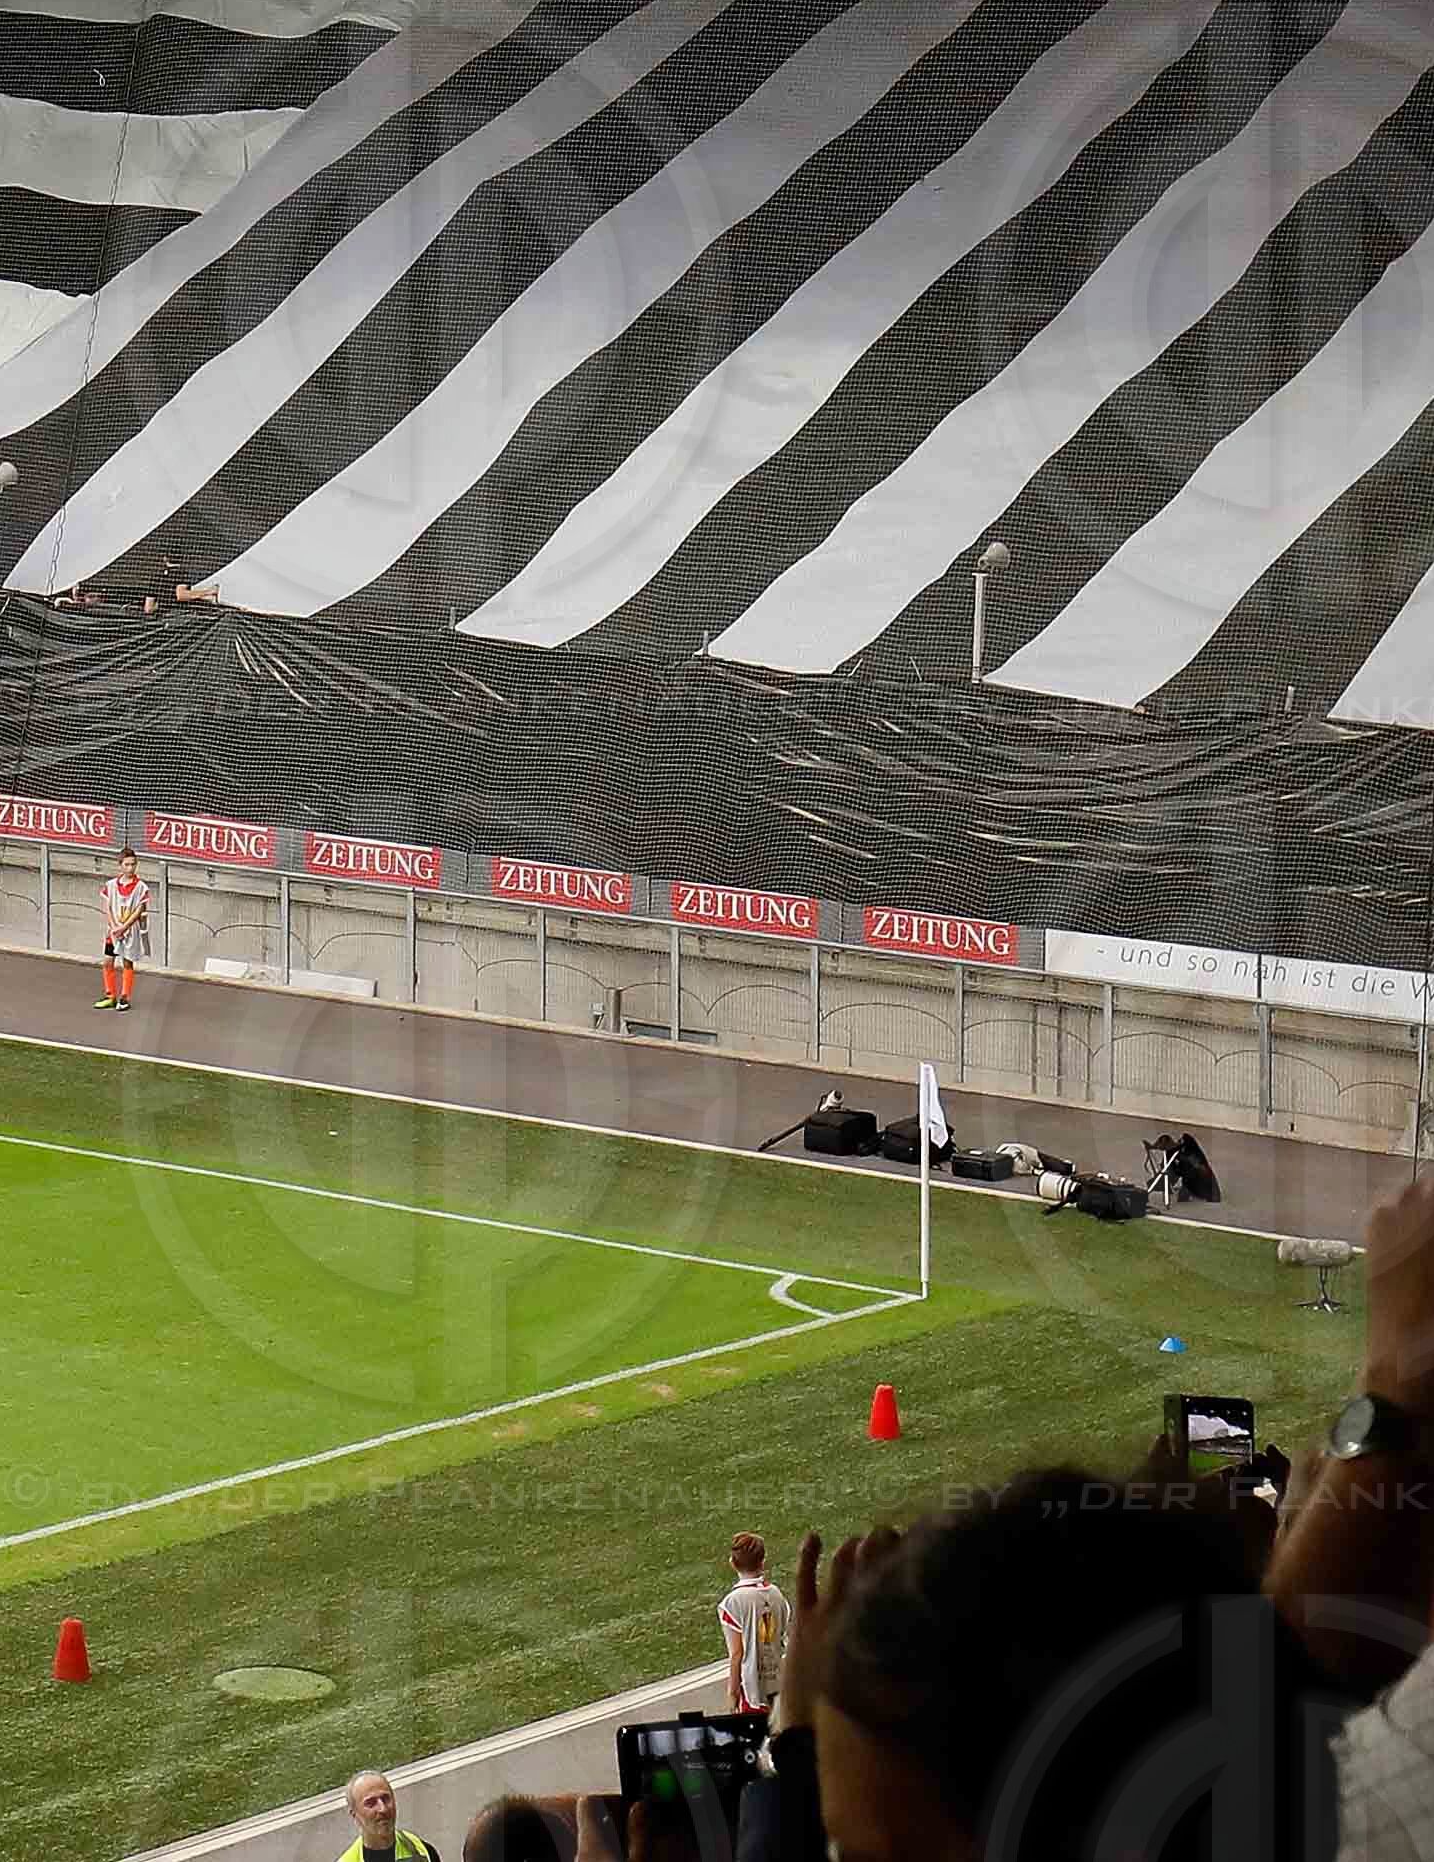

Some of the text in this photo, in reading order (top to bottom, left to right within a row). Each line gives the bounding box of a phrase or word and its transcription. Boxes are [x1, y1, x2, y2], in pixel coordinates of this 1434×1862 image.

[153, 819, 268, 859] ZEITUNG
[312, 841, 433, 880] ZEITUNG
[499, 863, 624, 904] ZEITUNG
[678, 887, 810, 928] ZEITUNG
[871, 911, 1010, 955] ZEITUNG
[1119, 944, 1172, 968] und
[1187, 954, 1220, 973] so
[1234, 956, 1288, 982] nah
[1302, 962, 1336, 988] ist
[1352, 969, 1396, 996] die
